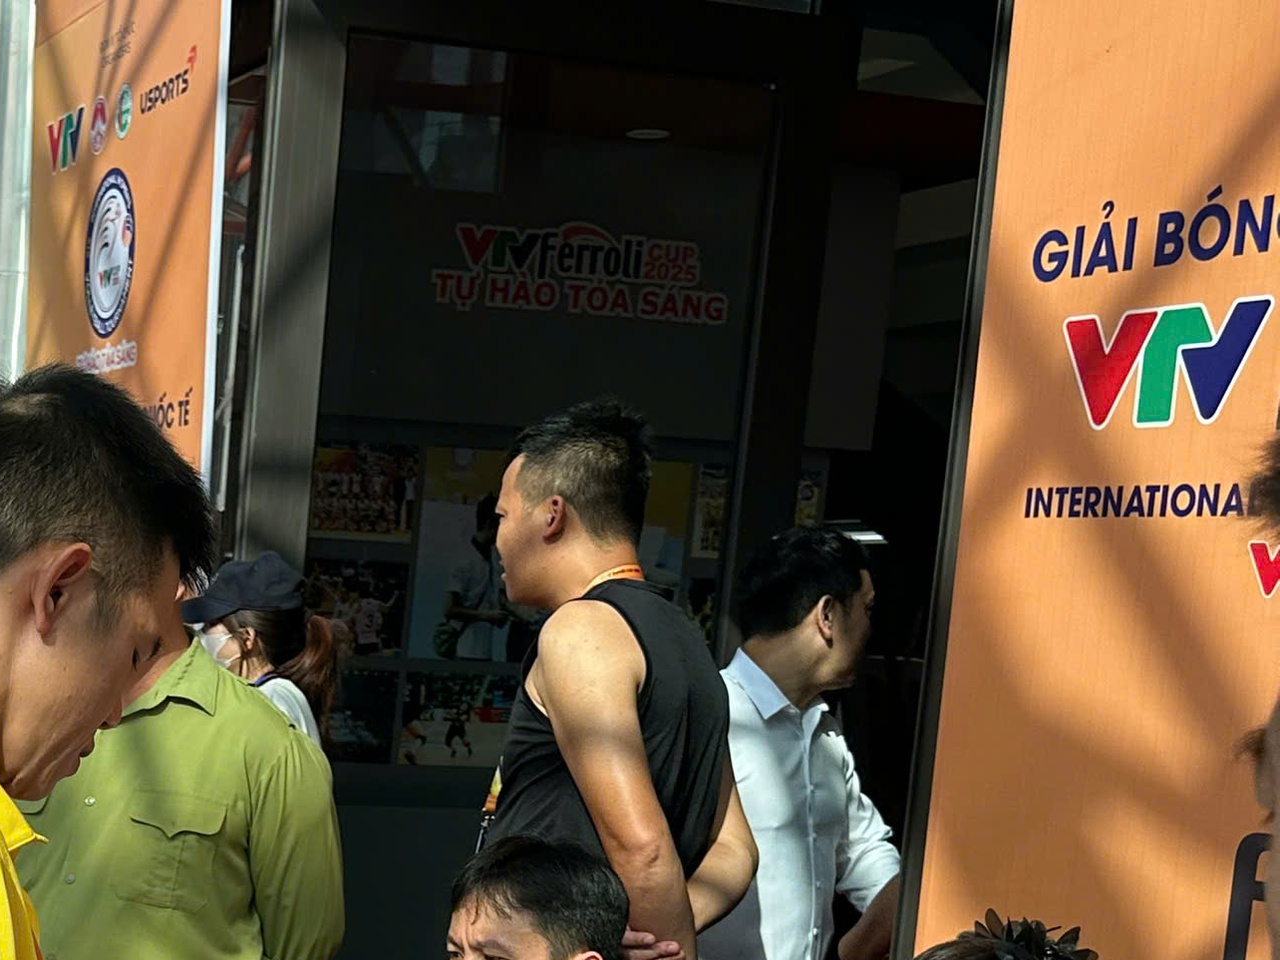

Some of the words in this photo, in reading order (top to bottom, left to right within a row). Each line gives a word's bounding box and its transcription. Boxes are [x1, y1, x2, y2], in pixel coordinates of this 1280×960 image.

[140, 68, 190, 115] USPORTS
[647, 243, 697, 262] CUP
[1032, 200, 1139, 282] GIẢI
[1153, 184, 1280, 268] BÓN
[434, 270, 481, 307] TỰ
[489, 268, 557, 307] HÀO
[569, 276, 631, 313] TỎA
[640, 282, 726, 321] SÁNG
[644, 262, 697, 282] 2025
[1064, 298, 1274, 428] VTV
[177, 385, 194, 427] TẾ
